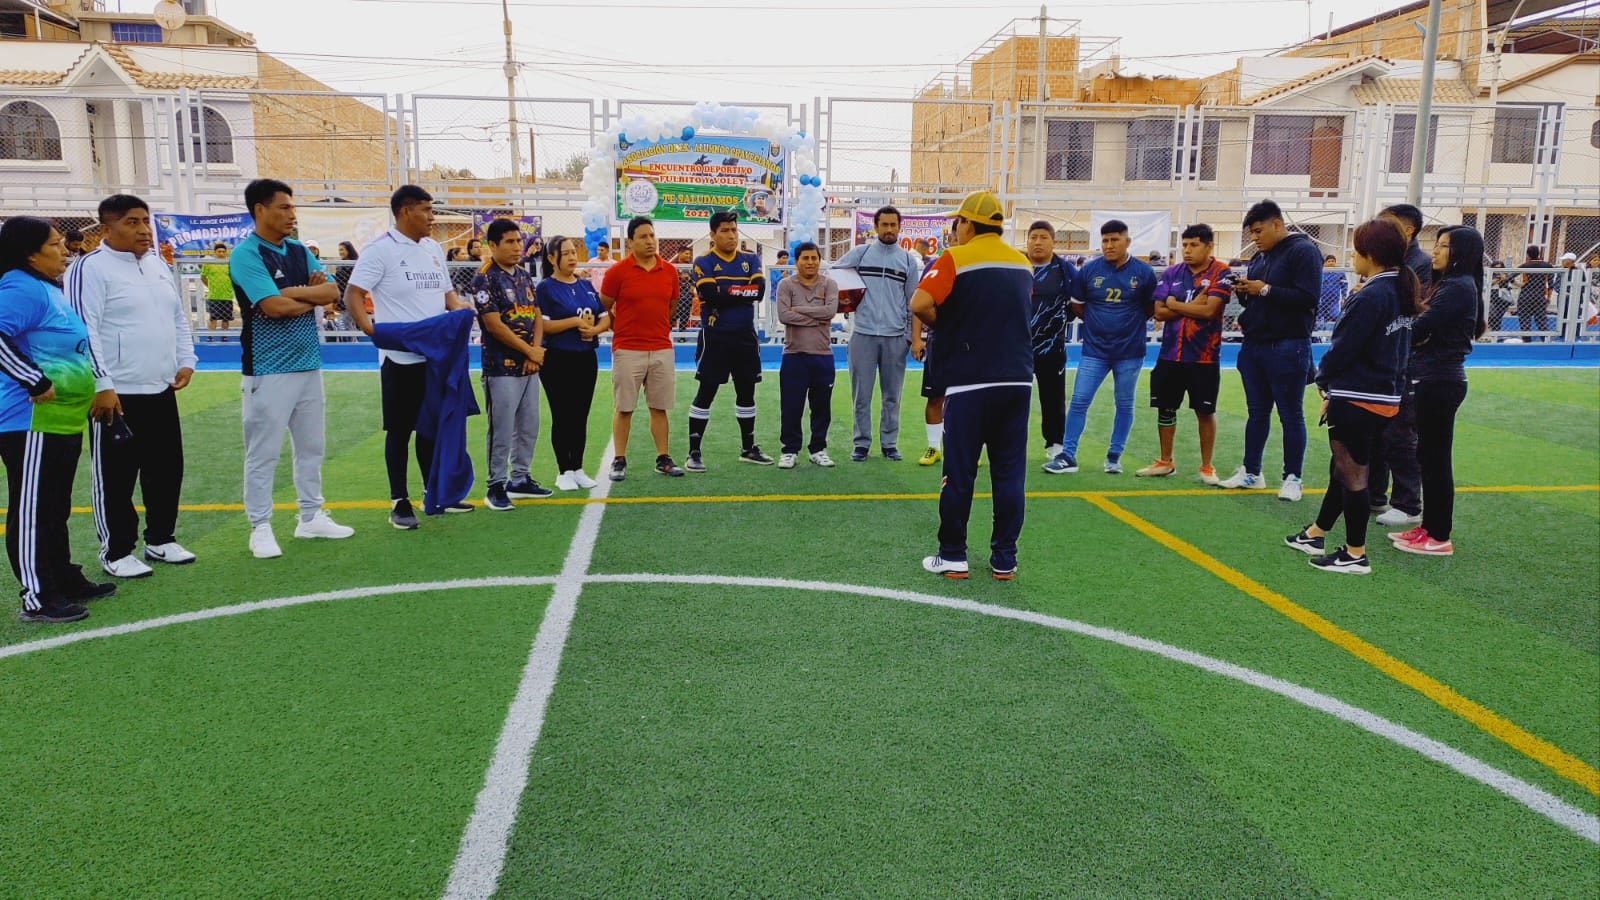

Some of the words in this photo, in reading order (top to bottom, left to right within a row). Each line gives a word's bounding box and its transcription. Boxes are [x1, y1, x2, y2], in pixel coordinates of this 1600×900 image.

[649, 163, 702, 173] ENCUENTRO
[704, 165, 753, 175] DEPORTIVO
[659, 175, 702, 184] FULBITO
[713, 177, 745, 185] VOLEY
[663, 193, 676, 203] TE
[677, 194, 739, 205] SALUDAMOS
[685, 209, 709, 217] 2022
[168, 225, 238, 248] PROMOCIÓN
[405, 271, 443, 281] Emirates
[1105, 287, 1121, 303] 22
